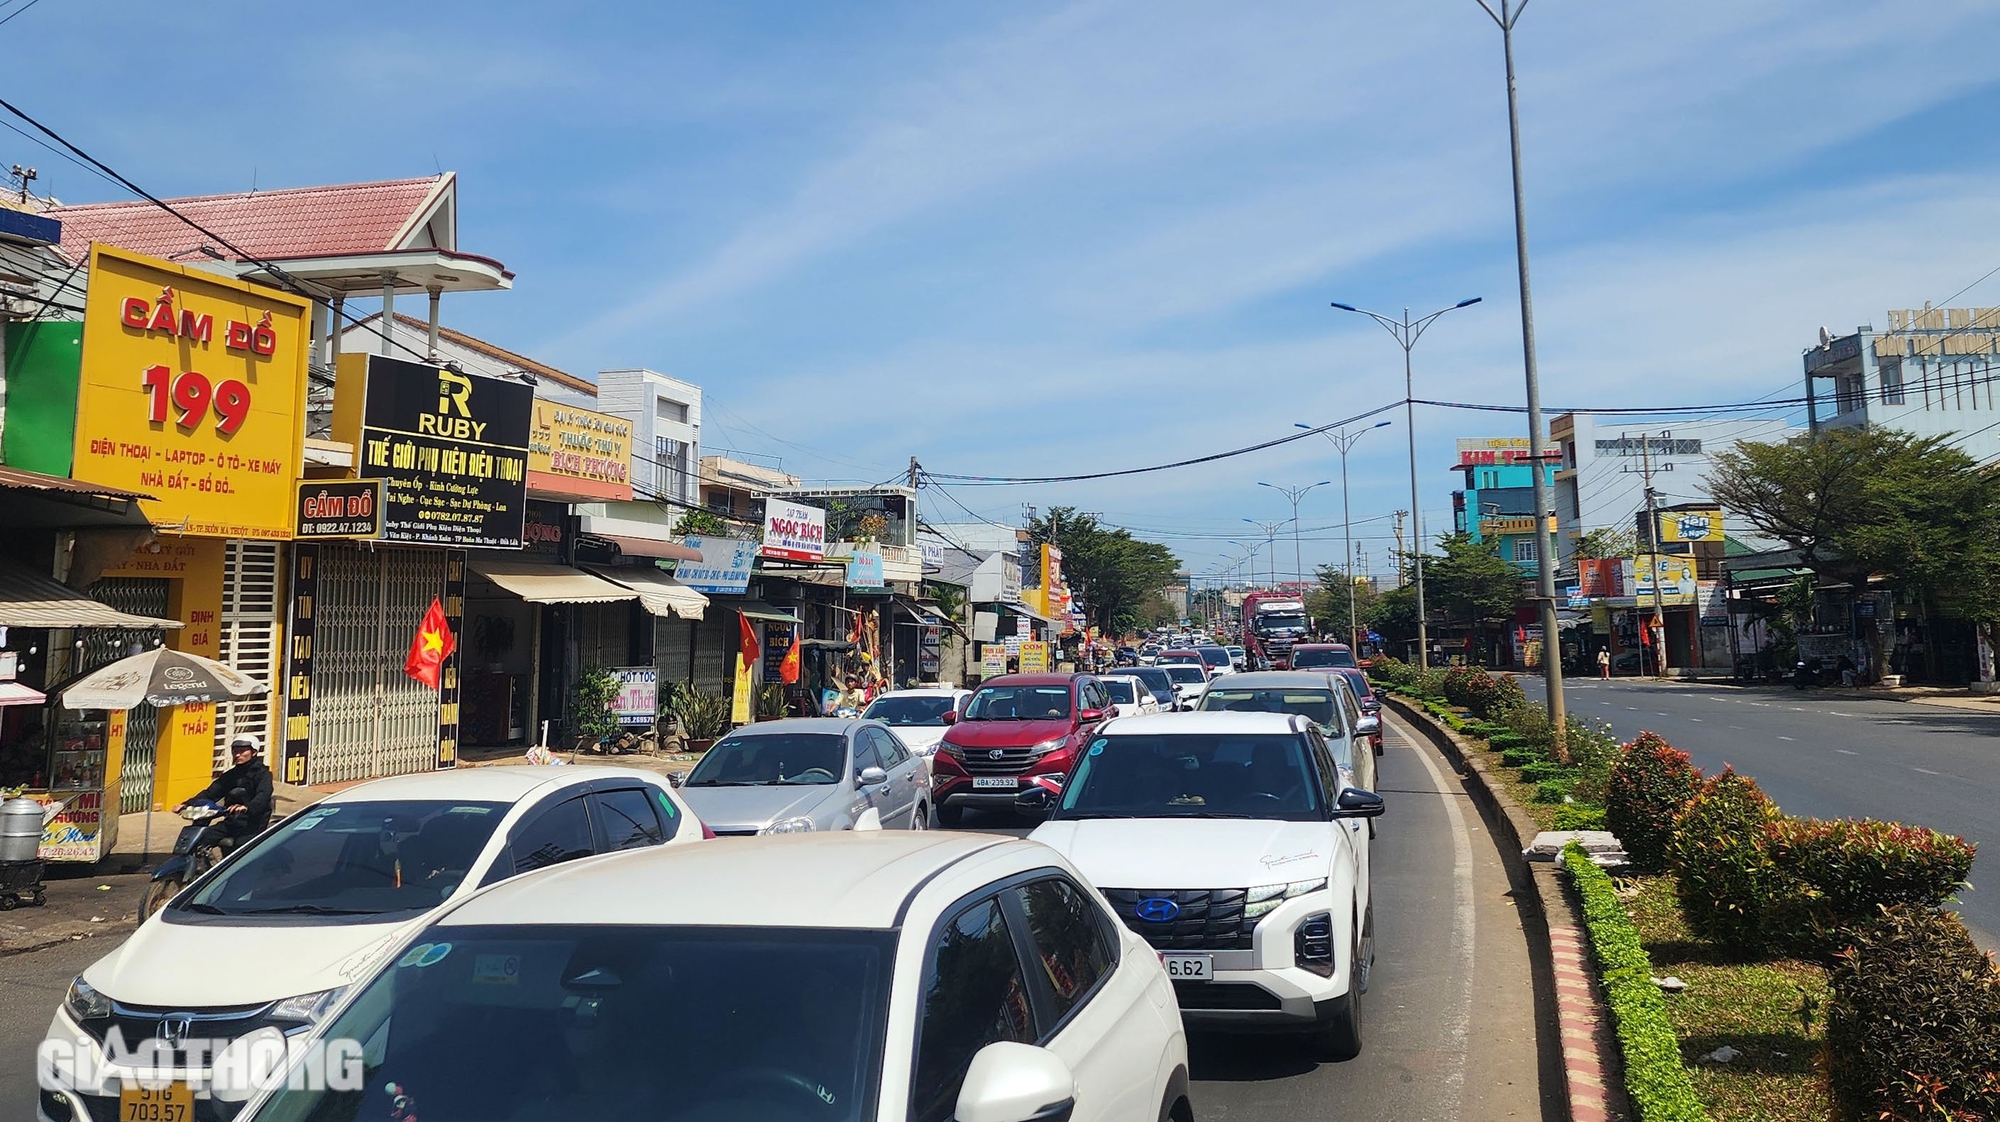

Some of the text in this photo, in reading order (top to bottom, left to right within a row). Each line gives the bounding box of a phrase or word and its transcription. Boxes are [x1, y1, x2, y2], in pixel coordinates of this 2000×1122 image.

[120, 286, 277, 356] CẦM ĐỒ
[142, 364, 251, 434] 199
[419, 413, 487, 441] RUBY
[560, 431, 592, 452] THUỐC
[595, 436, 613, 456] THÚ
[614, 441, 622, 457] Y
[91, 437, 115, 458] ĐIỆN
[120, 443, 151, 463] THOẠI
[165, 449, 205, 465] LAPTOP
[217, 452, 224, 468] Ô
[247, 458, 260, 473] XE
[262, 459, 281, 475] MÁY
[368, 435, 523, 486] THẾ GIỚI PHỤ KIỆN ĐIỆN THOẠI
[552, 447, 581, 472] BÍCH
[584, 457, 627, 481] PHƯỢNG
[1461, 451, 1495, 464] KIM
[141, 470, 163, 488] NHÀ
[168, 470, 189, 489] ĐẤT
[412, 475, 423, 490] Ốp
[304, 489, 372, 518] CẦM ĐỒ
[398, 494, 415, 506] Nghe
[433, 497, 445, 508] Sạc
[449, 499, 461, 510] Sạc
[431, 511, 484, 523] 0782.07.87.87
[316, 522, 372, 533] 0922.47.1234
[771, 517, 823, 540] NGỌC BÍCH
[136, 560, 159, 571] NHÀ
[164, 558, 186, 571] ĐẤT
[298, 590, 313, 619] TÍN
[191, 611, 214, 626] ĐỊNH
[192, 629, 208, 645] GIÁ
[769, 634, 789, 647] BÍCH
[294, 635, 312, 664] TẠO
[163, 680, 207, 690] Legend
[639, 669, 656, 682] TÓC
[290, 671, 310, 700] NÊN
[630, 689, 655, 709] Thái
[182, 716, 208, 735] THẤP
[141, 1083, 172, 1101] 51G
[128, 1103, 187, 1122] 703.57
